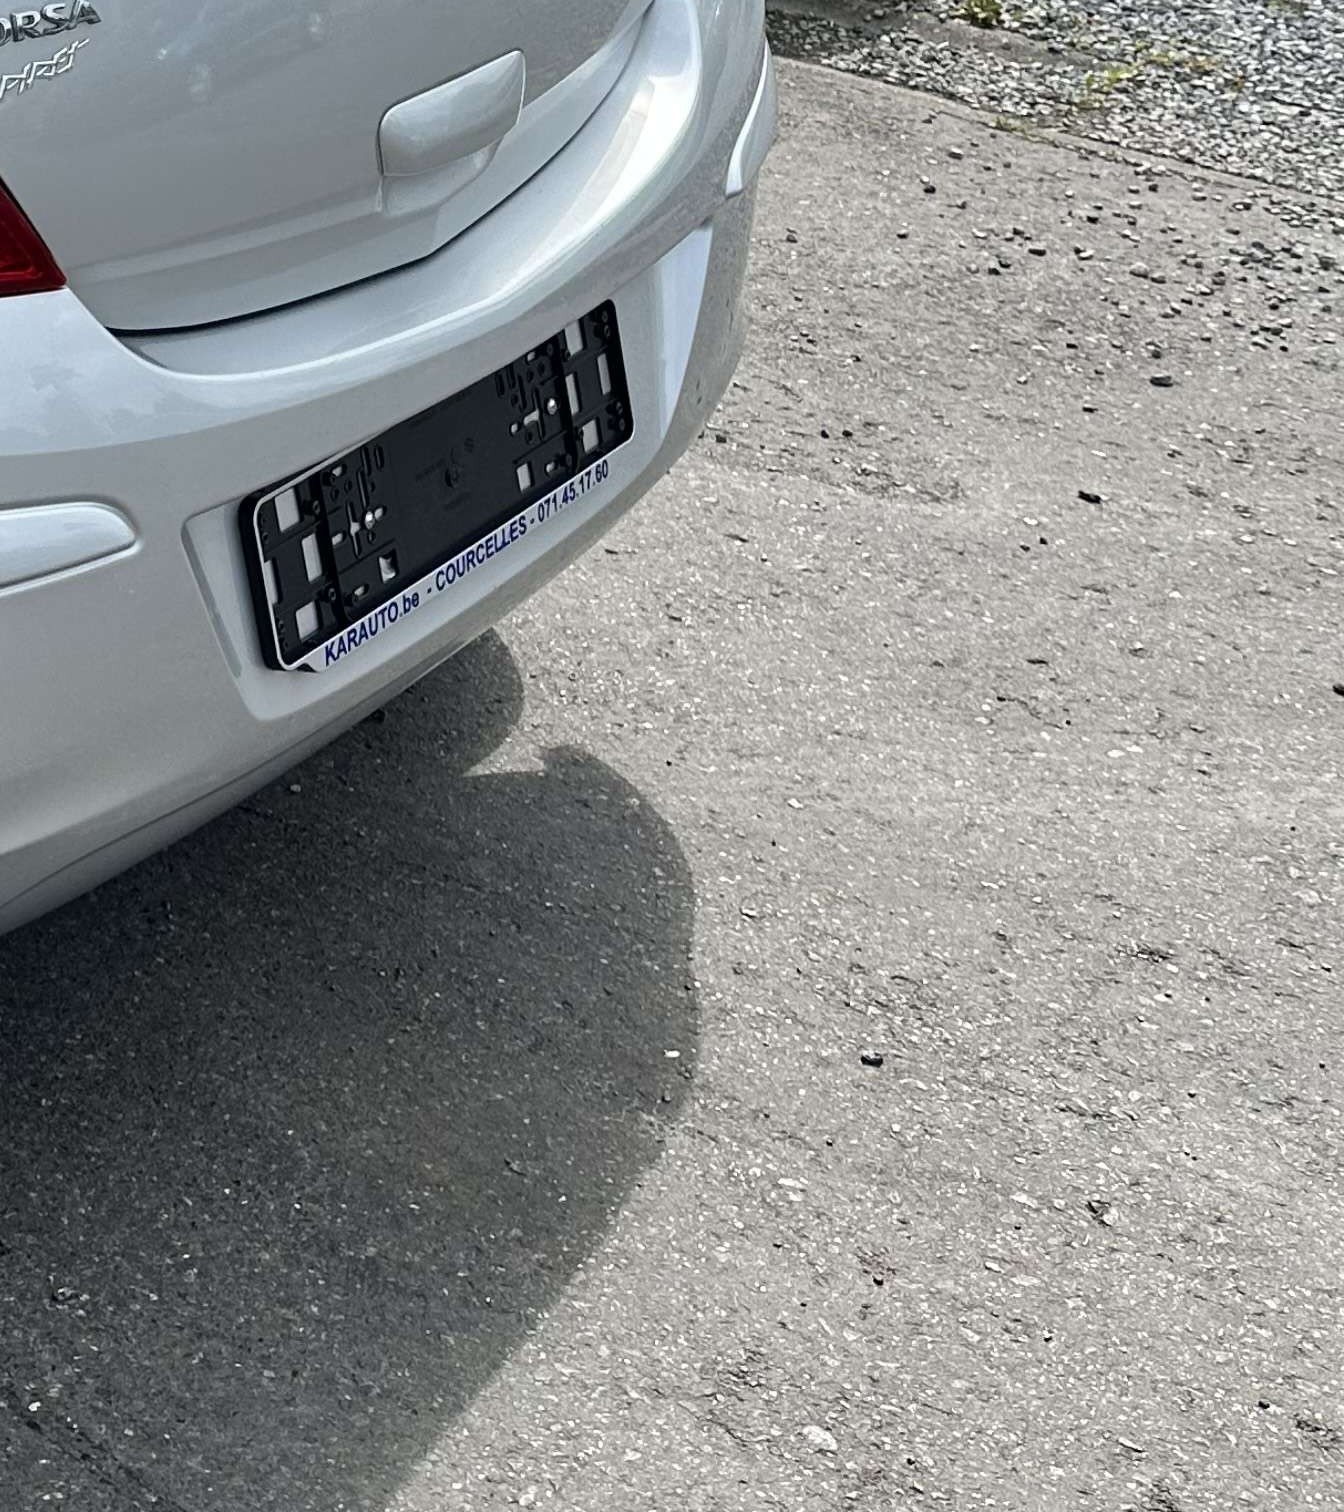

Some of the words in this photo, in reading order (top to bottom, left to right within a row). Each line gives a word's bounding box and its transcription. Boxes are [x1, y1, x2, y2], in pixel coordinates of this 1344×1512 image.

[324, 592, 420, 666] KARAUTO.be
[435, 516, 528, 592] COURCELLES
[537, 459, 609, 524] 071.45.17.60
